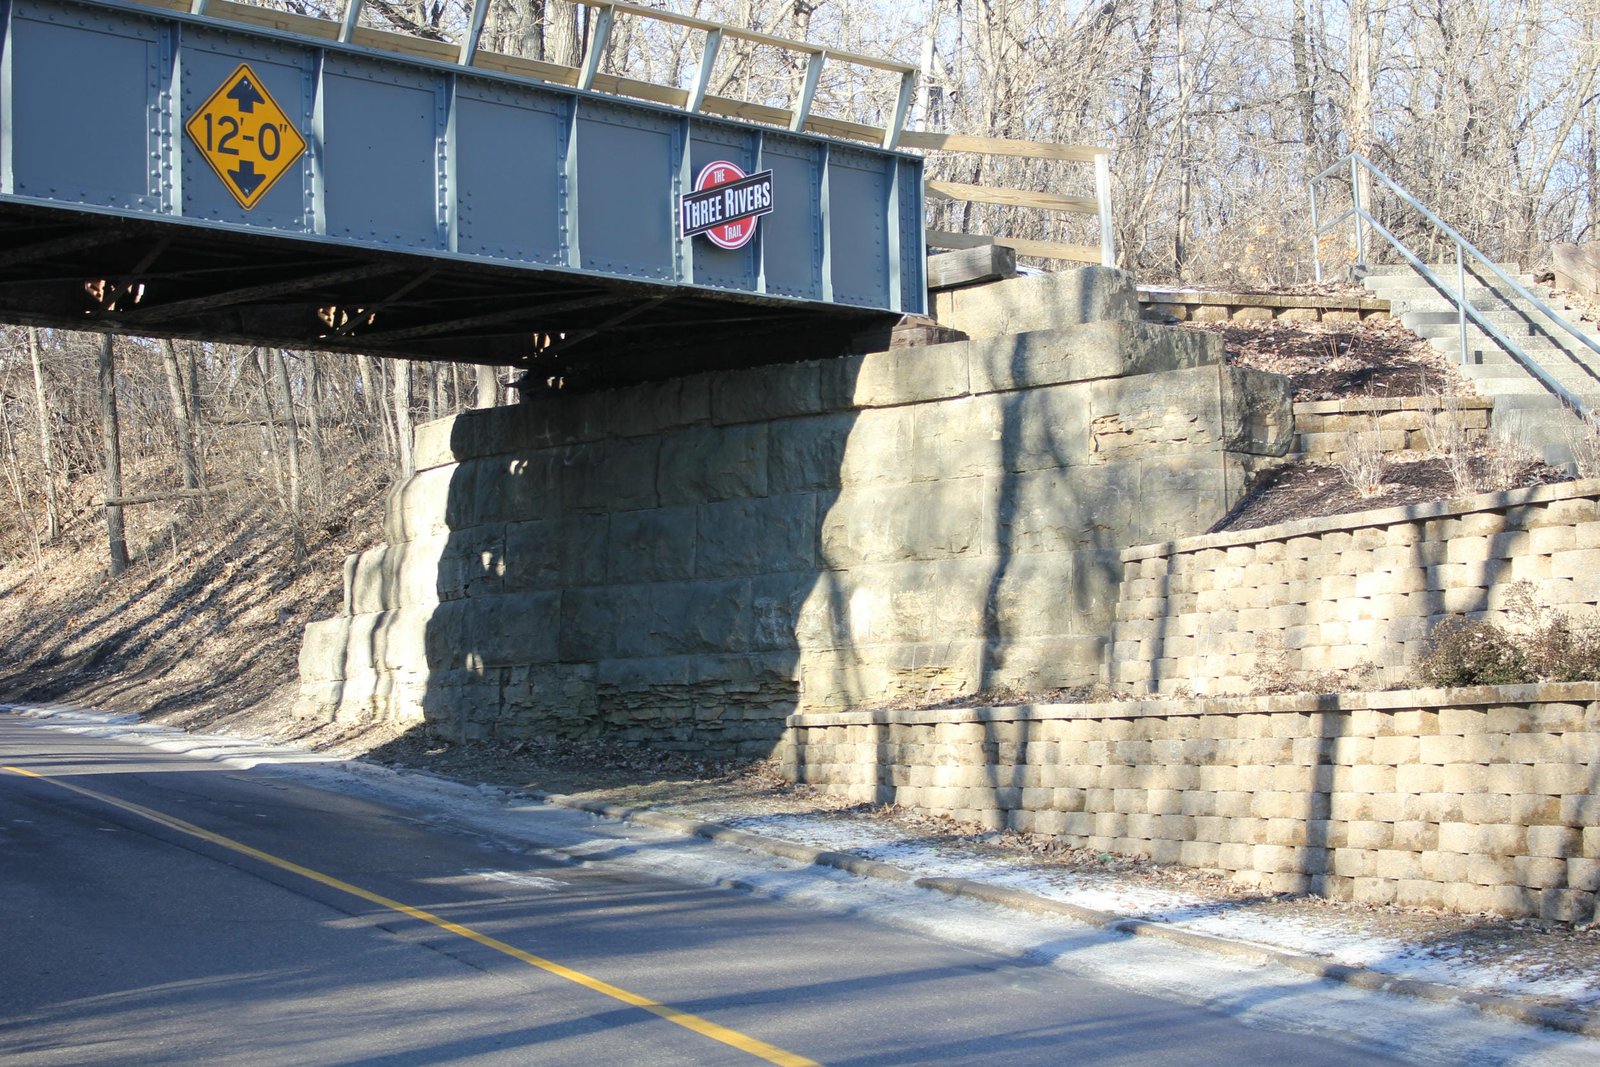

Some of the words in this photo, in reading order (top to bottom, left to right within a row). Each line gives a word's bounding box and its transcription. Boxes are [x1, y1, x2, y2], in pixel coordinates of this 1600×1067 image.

[714, 169, 725, 183] THE
[684, 196, 722, 229] THREE
[725, 182, 770, 218] RIVERS
[724, 224, 742, 240] TRAIL
